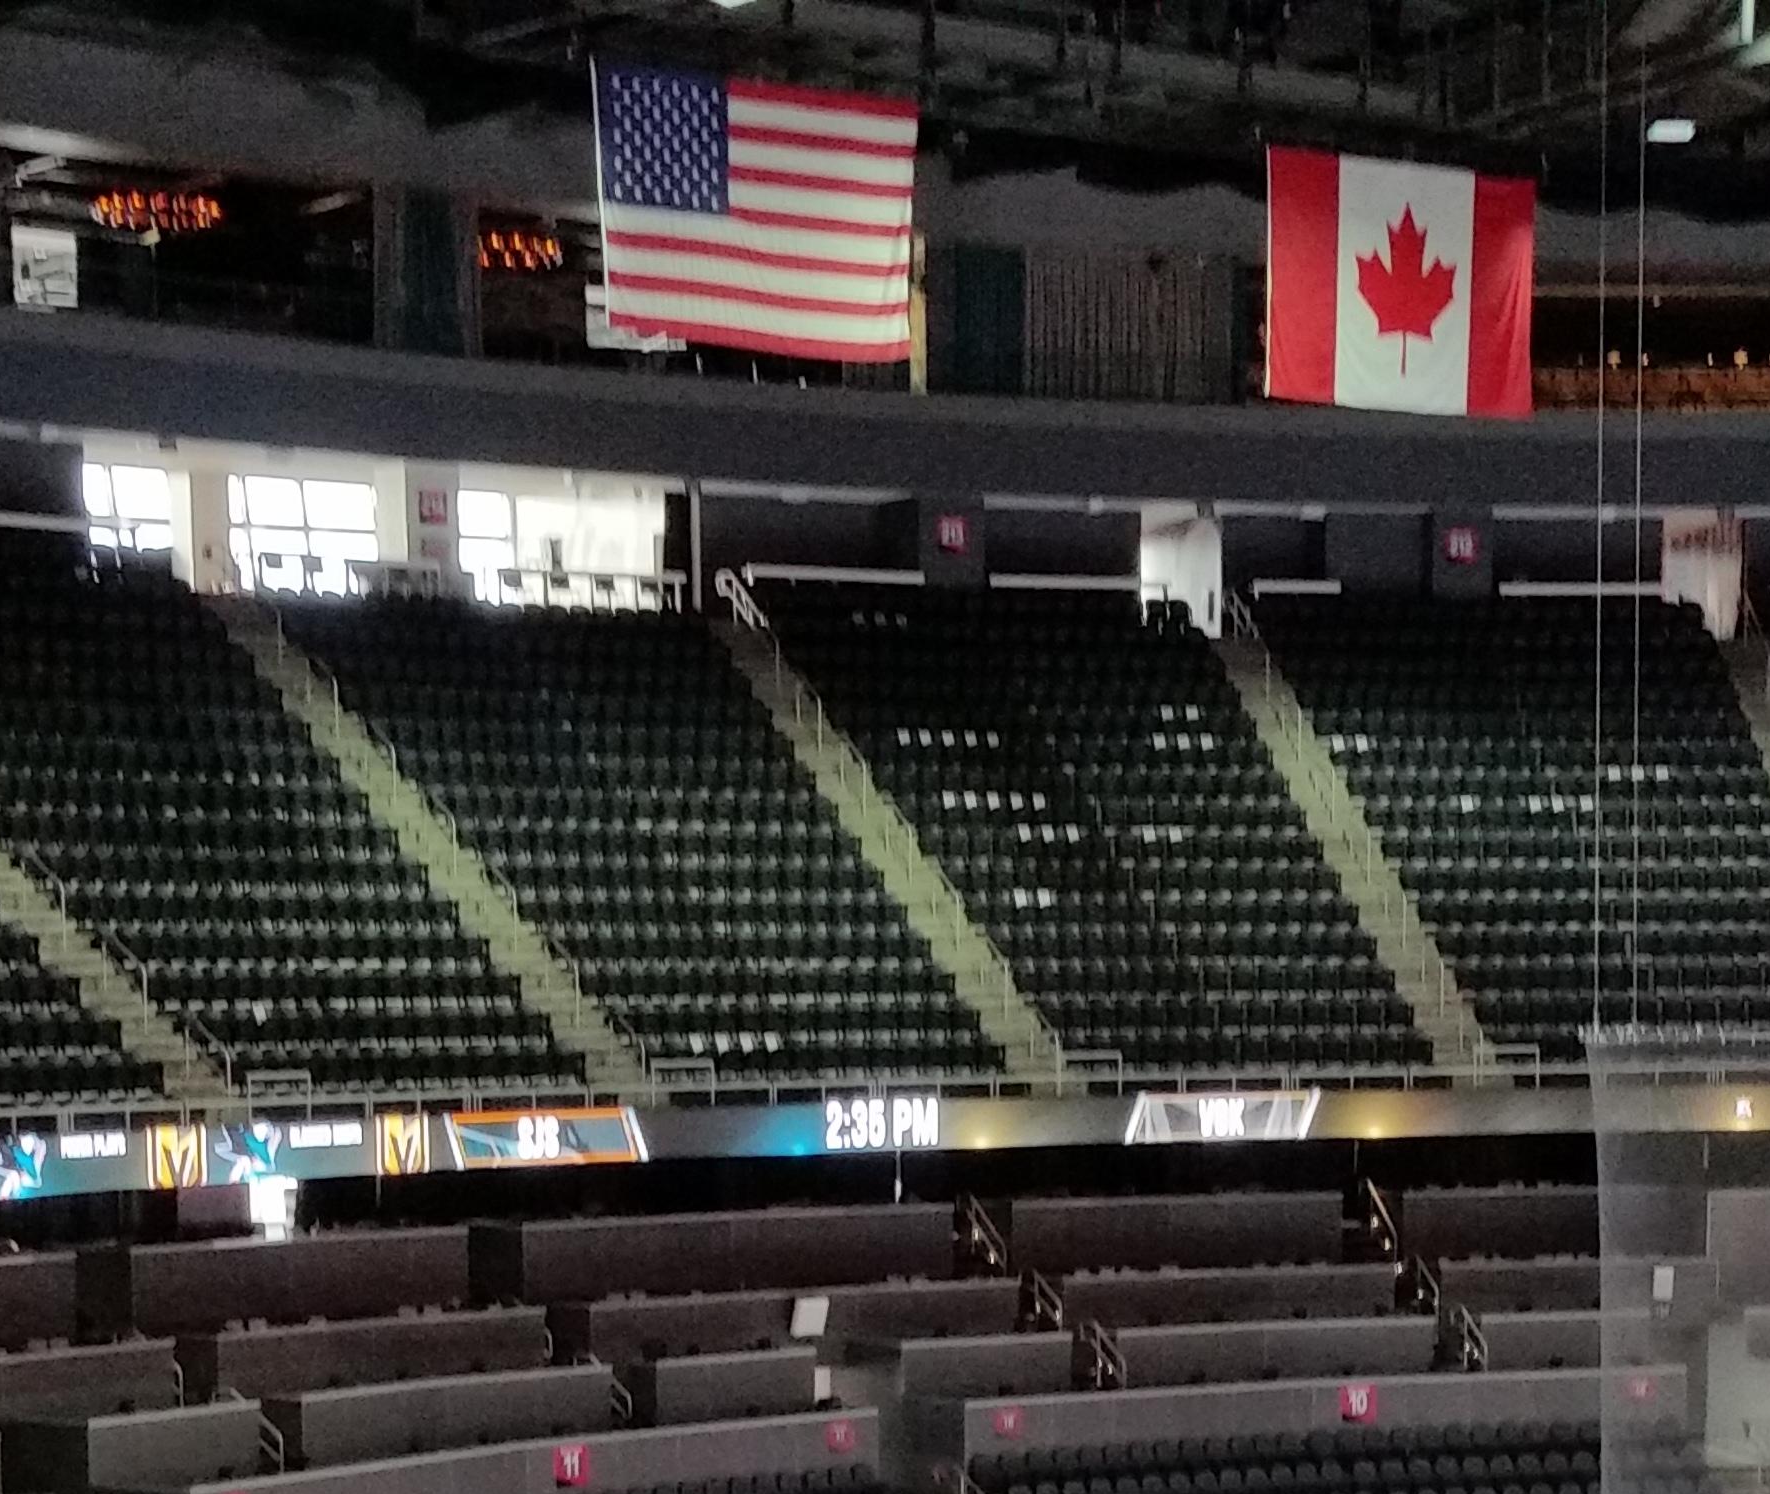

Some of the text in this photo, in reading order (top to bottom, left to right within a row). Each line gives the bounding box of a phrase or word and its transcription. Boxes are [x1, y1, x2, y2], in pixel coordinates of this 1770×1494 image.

[826, 1098, 939, 1149] 2:35 PM
[1348, 1388, 1368, 1416] 10
[562, 1450, 581, 1481] 11
